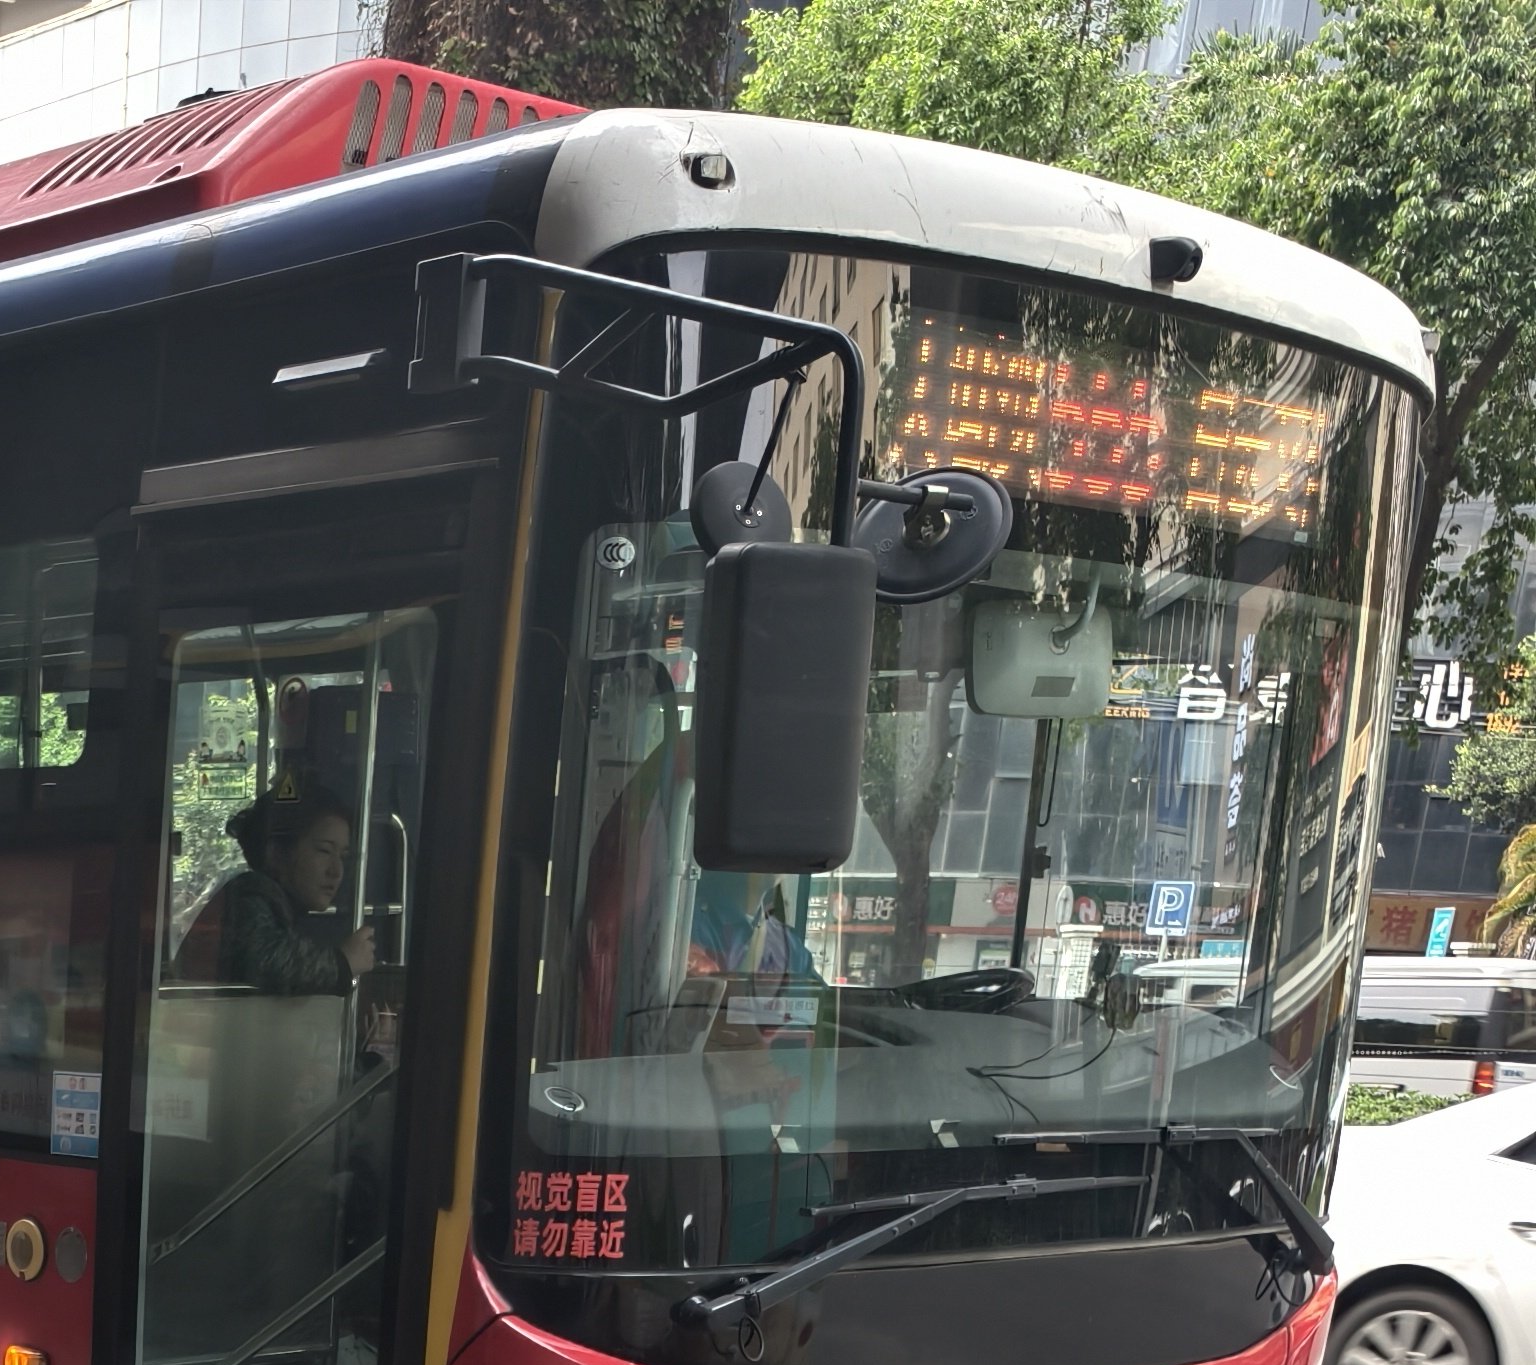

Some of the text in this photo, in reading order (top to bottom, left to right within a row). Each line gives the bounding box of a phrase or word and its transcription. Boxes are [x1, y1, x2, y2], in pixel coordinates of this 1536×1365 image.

[515, 1170, 630, 1213] 视觉盲区
[514, 1217, 625, 1259] 请勿靠近
